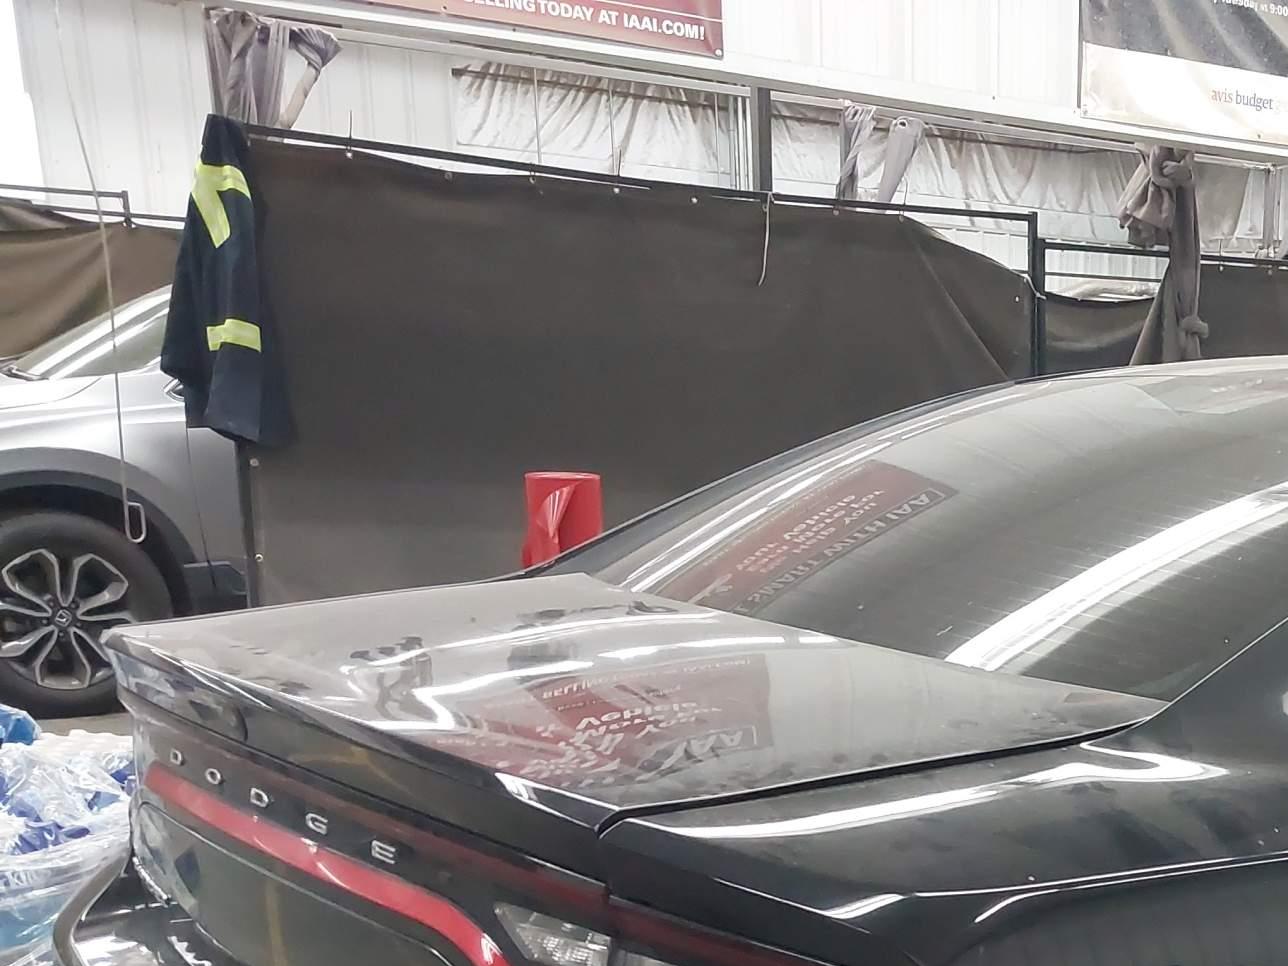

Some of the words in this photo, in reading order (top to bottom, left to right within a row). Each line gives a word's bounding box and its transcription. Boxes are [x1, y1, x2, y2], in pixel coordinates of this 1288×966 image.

[464, 0, 536, 13] LING
[539, 0, 594, 22] TODAY
[598, 9, 618, 26] AT
[623, 12, 706, 41] IAAI.COM!
[1269, 3, 1288, 17] 9:00
[1211, 88, 1233, 104] avis
[1235, 89, 1274, 112] budget
[169, 749, 397, 865] DODGE
